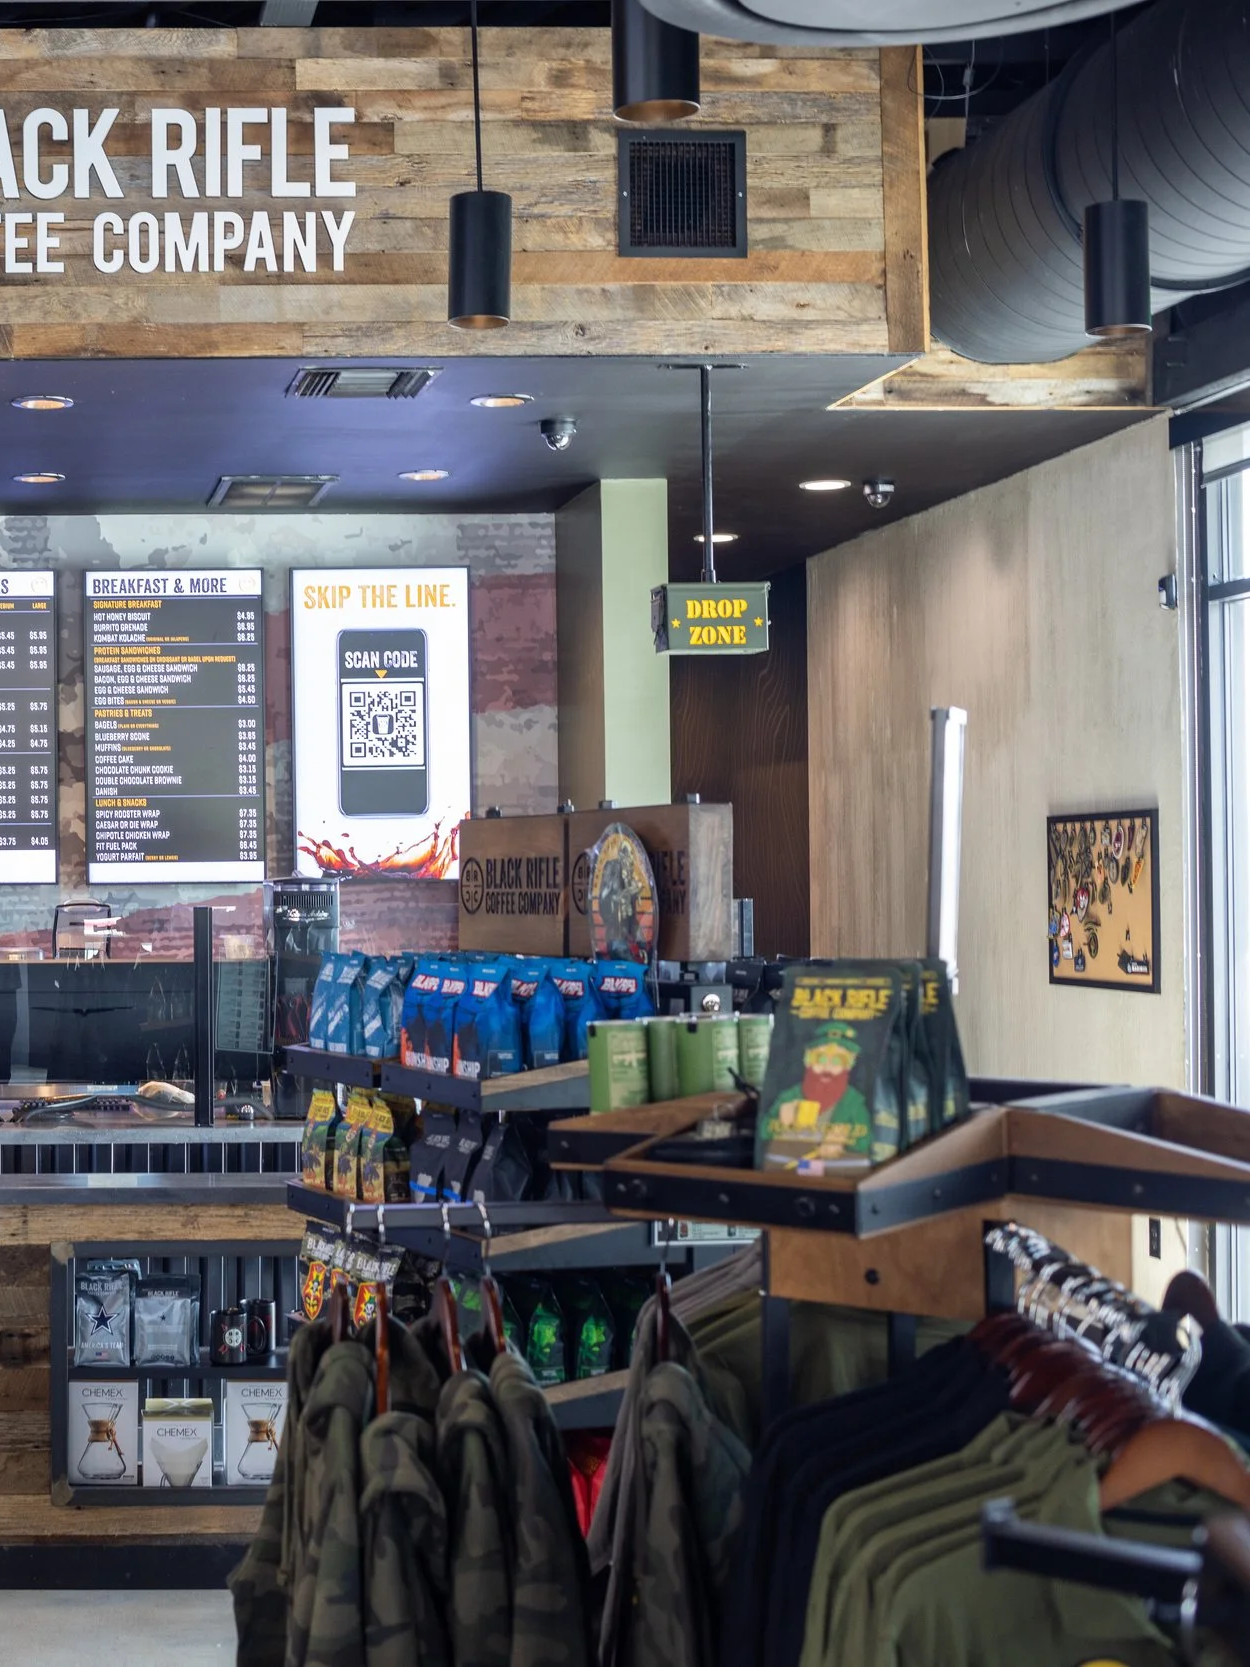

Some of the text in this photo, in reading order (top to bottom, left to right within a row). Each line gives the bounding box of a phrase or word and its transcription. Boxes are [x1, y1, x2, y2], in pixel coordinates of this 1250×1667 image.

[152, 106, 357, 199] RIFLE
[93, 210, 356, 275] COMPANY
[93, 577, 227, 594] BREAKFAST & MORE
[304, 584, 456, 609] SKIP THE LINE.
[94, 600, 162, 608] SIGNATURE BREAKFAST
[686, 599, 748, 619] DROP
[94, 612, 150, 621] HOT HONEY BISCUIT
[94, 623, 148, 632] BURRITO GRENADE
[689, 625, 747, 645] ZONE
[94, 646, 161, 655] PROTEIN SANDWICHES
[345, 650, 418, 668] SCAN CODE
[94, 721, 117, 729] BAGELS
[95, 744, 121, 752] MUFFINS
[95, 755, 134, 764] COFFEE CAKE
[96, 766, 174, 774] CHOCOLATE CHUNK COOKIE
[96, 788, 118, 796] DANISH
[96, 810, 160, 818] SPICY ROOSTER WRAP
[485, 856, 560, 890] BLACK RIFLE
[485, 891, 561, 915] COFFEE COMPANY
[792, 988, 893, 1010] BLACK RIFLE
[81, 1281, 103, 1292] BLACK
[82, 1388, 123, 1398] CHEMEX
[241, 1387, 283, 1398] CHEMEX
[156, 1427, 198, 1438] CHEMEX
